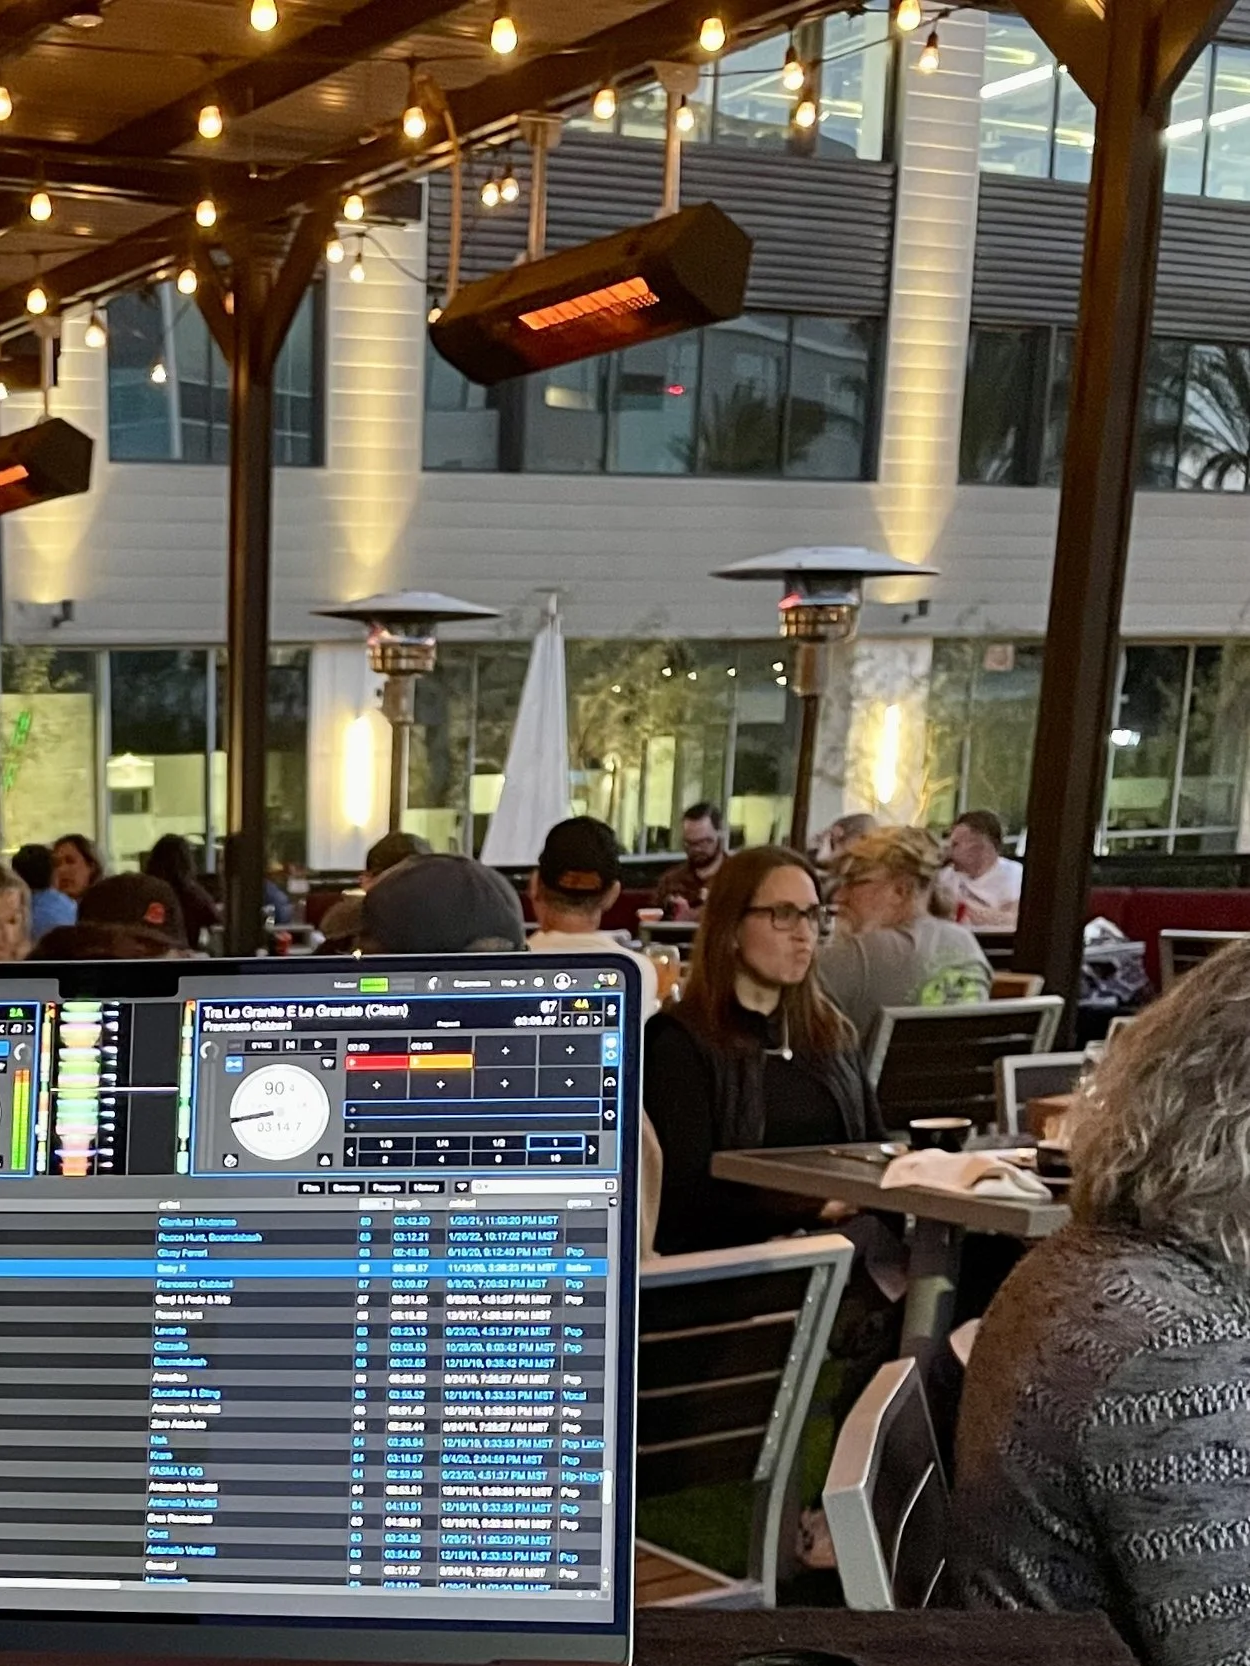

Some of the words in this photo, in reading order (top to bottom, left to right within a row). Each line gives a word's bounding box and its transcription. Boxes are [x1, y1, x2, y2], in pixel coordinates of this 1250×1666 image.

[203, 1006, 223, 1019] Tra
[287, 1005, 296, 1017] E
[365, 1003, 409, 1019] (Clean)
[522, 1216, 536, 1225] PM
[538, 1216, 559, 1225] MST
[522, 1232, 536, 1241] PM
[538, 1232, 558, 1241] MST
[566, 1248, 584, 1258] Pop
[565, 1280, 583, 1289] Pop
[514, 1328, 529, 1336] PM
[530, 1328, 551, 1337] MST
[564, 1328, 582, 1337] Pop
